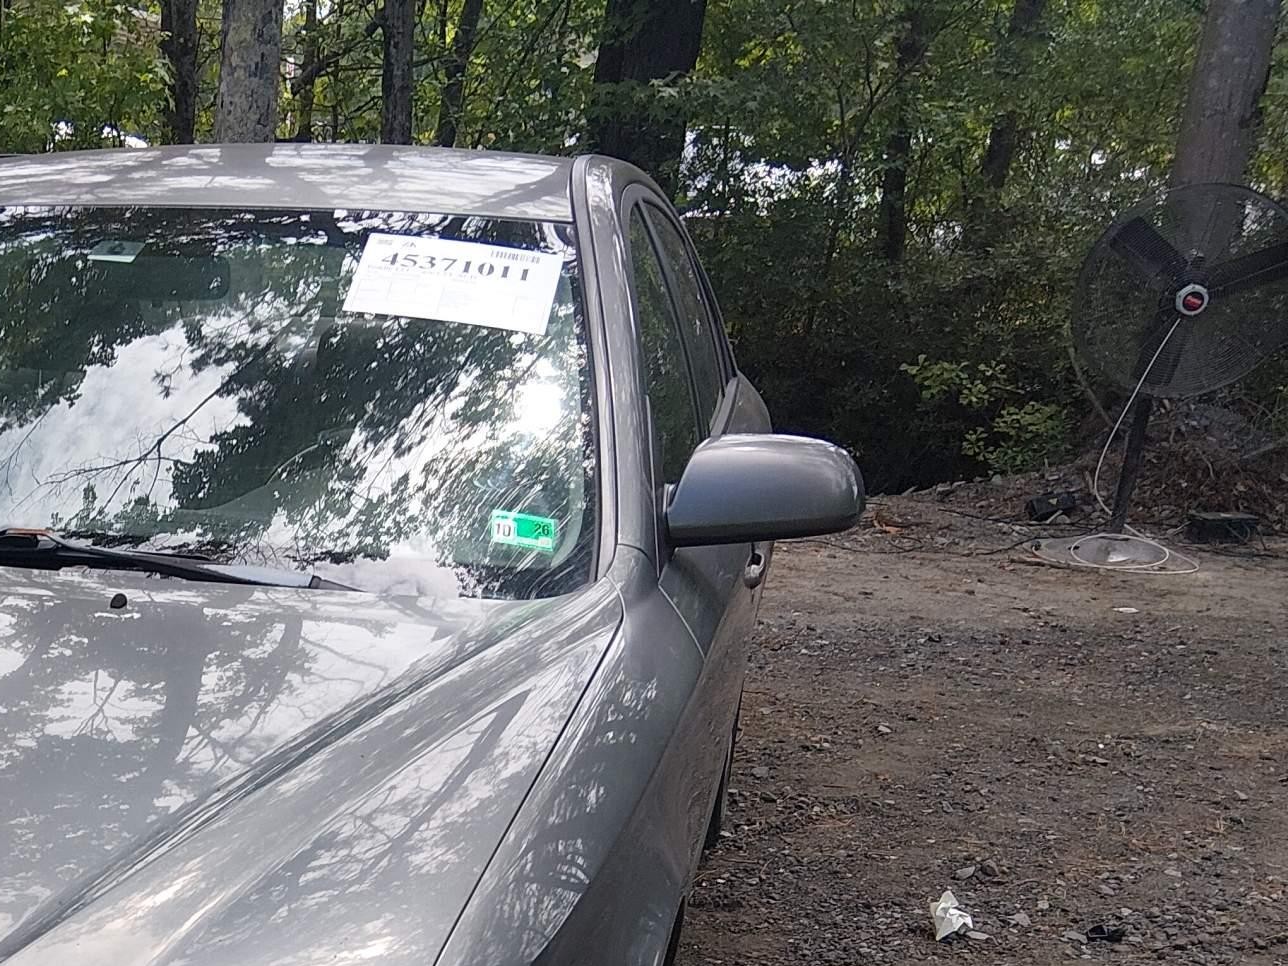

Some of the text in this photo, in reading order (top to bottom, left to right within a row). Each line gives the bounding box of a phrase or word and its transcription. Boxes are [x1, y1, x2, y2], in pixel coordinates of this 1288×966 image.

[381, 252, 530, 281] 45371011
[495, 522, 550, 538] 10 26
